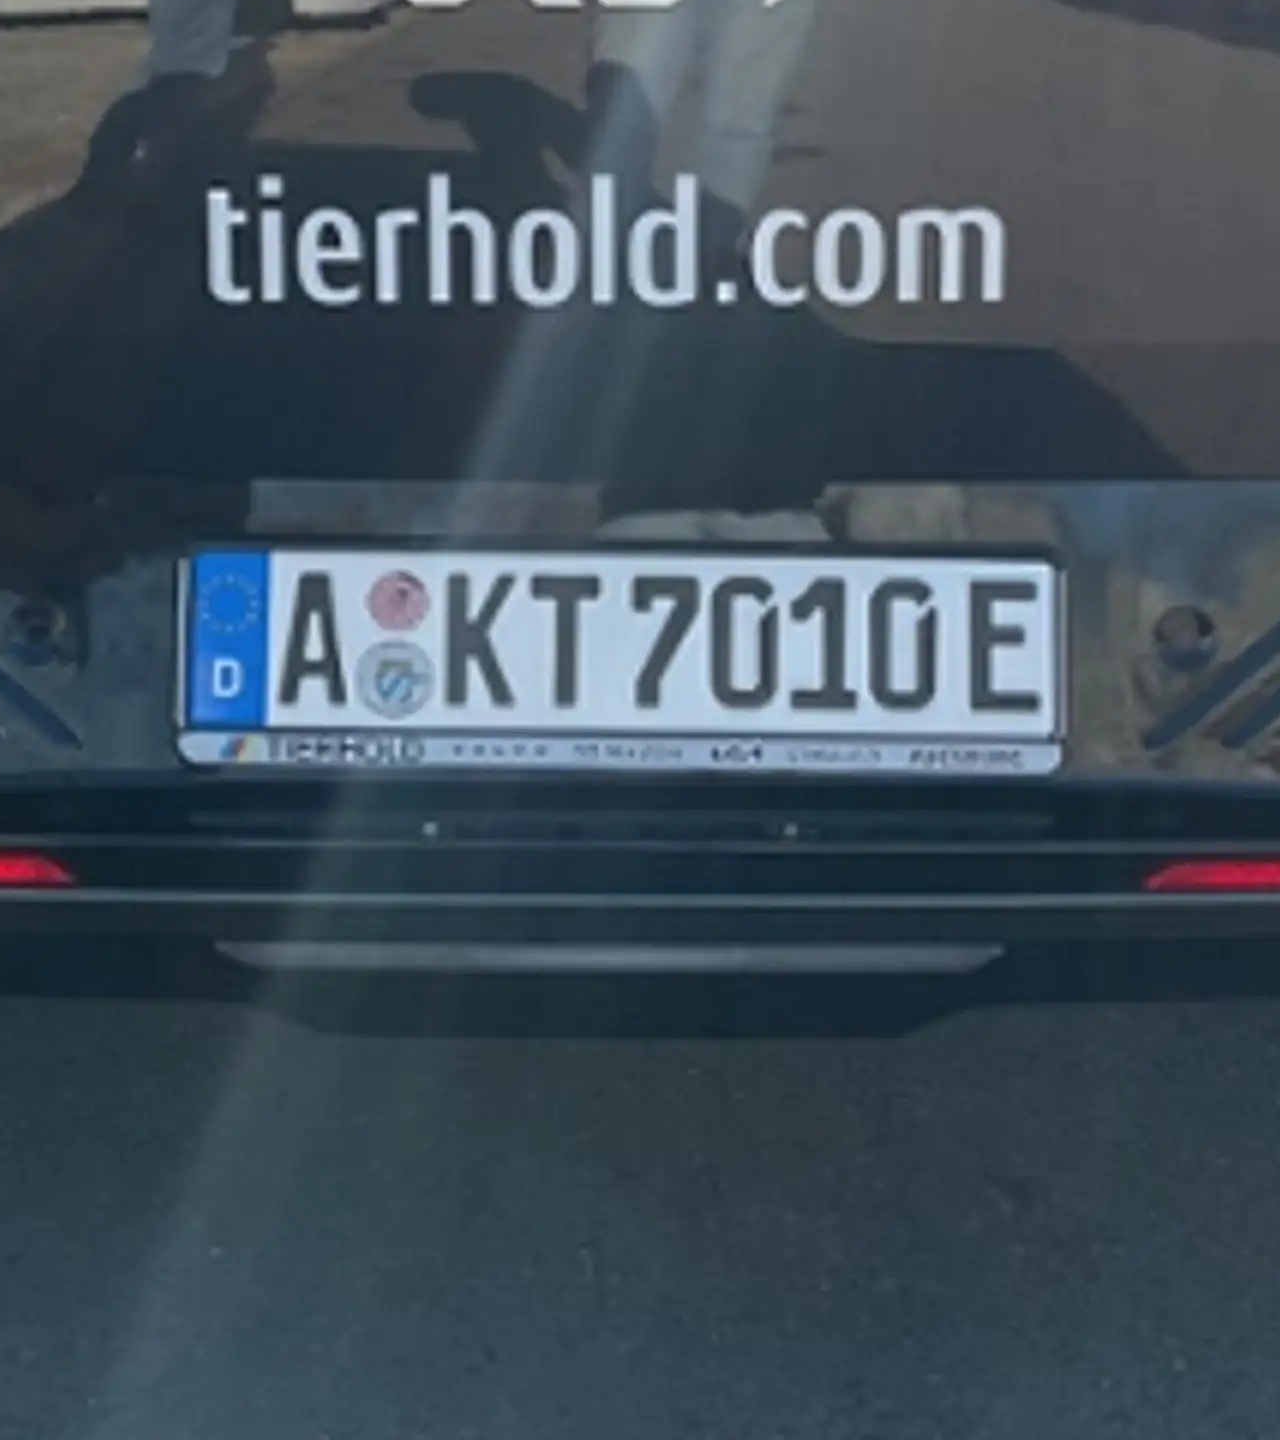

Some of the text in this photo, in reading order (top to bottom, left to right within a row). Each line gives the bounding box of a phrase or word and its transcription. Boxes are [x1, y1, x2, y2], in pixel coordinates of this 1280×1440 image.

[206, 173, 1005, 306] tierhold.com
[212, 657, 243, 698] D
[278, 570, 347, 706] A
[444, 572, 600, 708] KT
[632, 574, 938, 712] 7010
